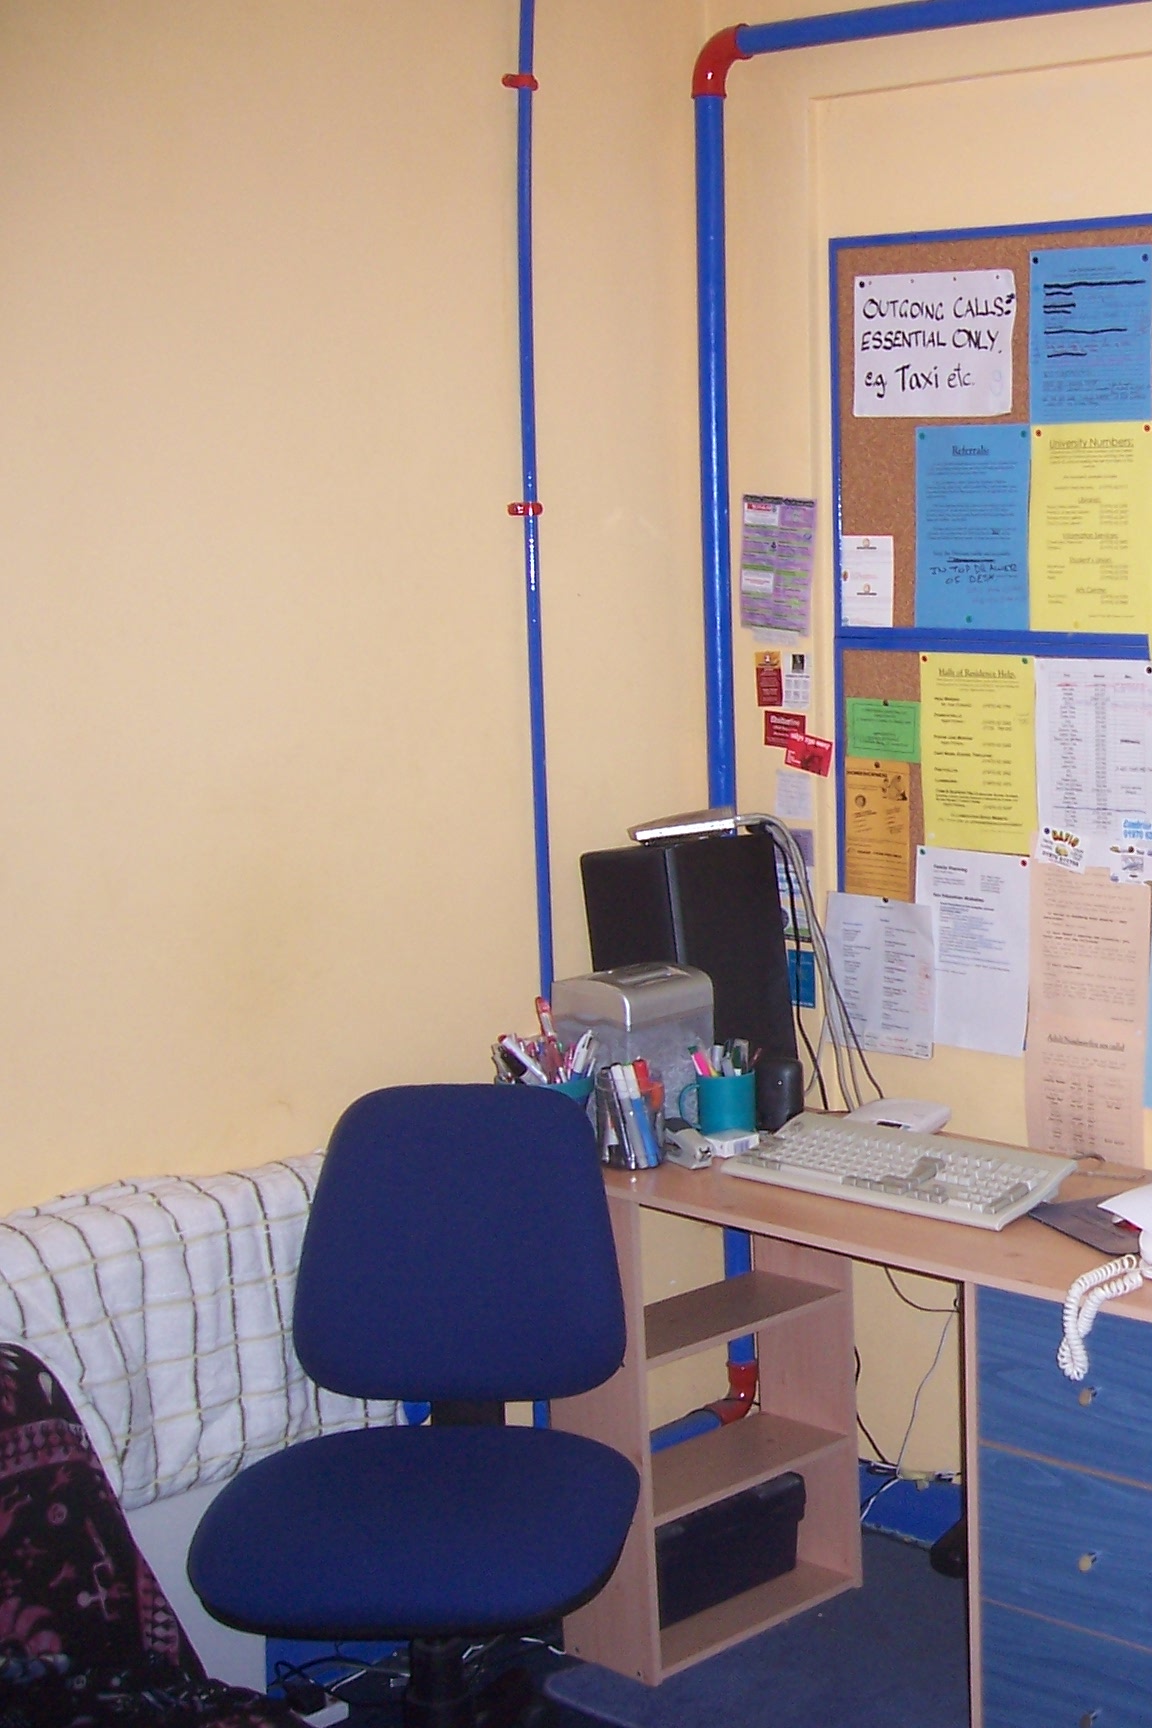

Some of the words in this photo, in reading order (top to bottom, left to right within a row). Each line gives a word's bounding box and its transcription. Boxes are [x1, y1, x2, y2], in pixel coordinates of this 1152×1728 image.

[863, 298, 944, 320] OUTGOING
[861, 328, 946, 351] ESSENTIAL
[895, 364, 939, 392] Taxi
